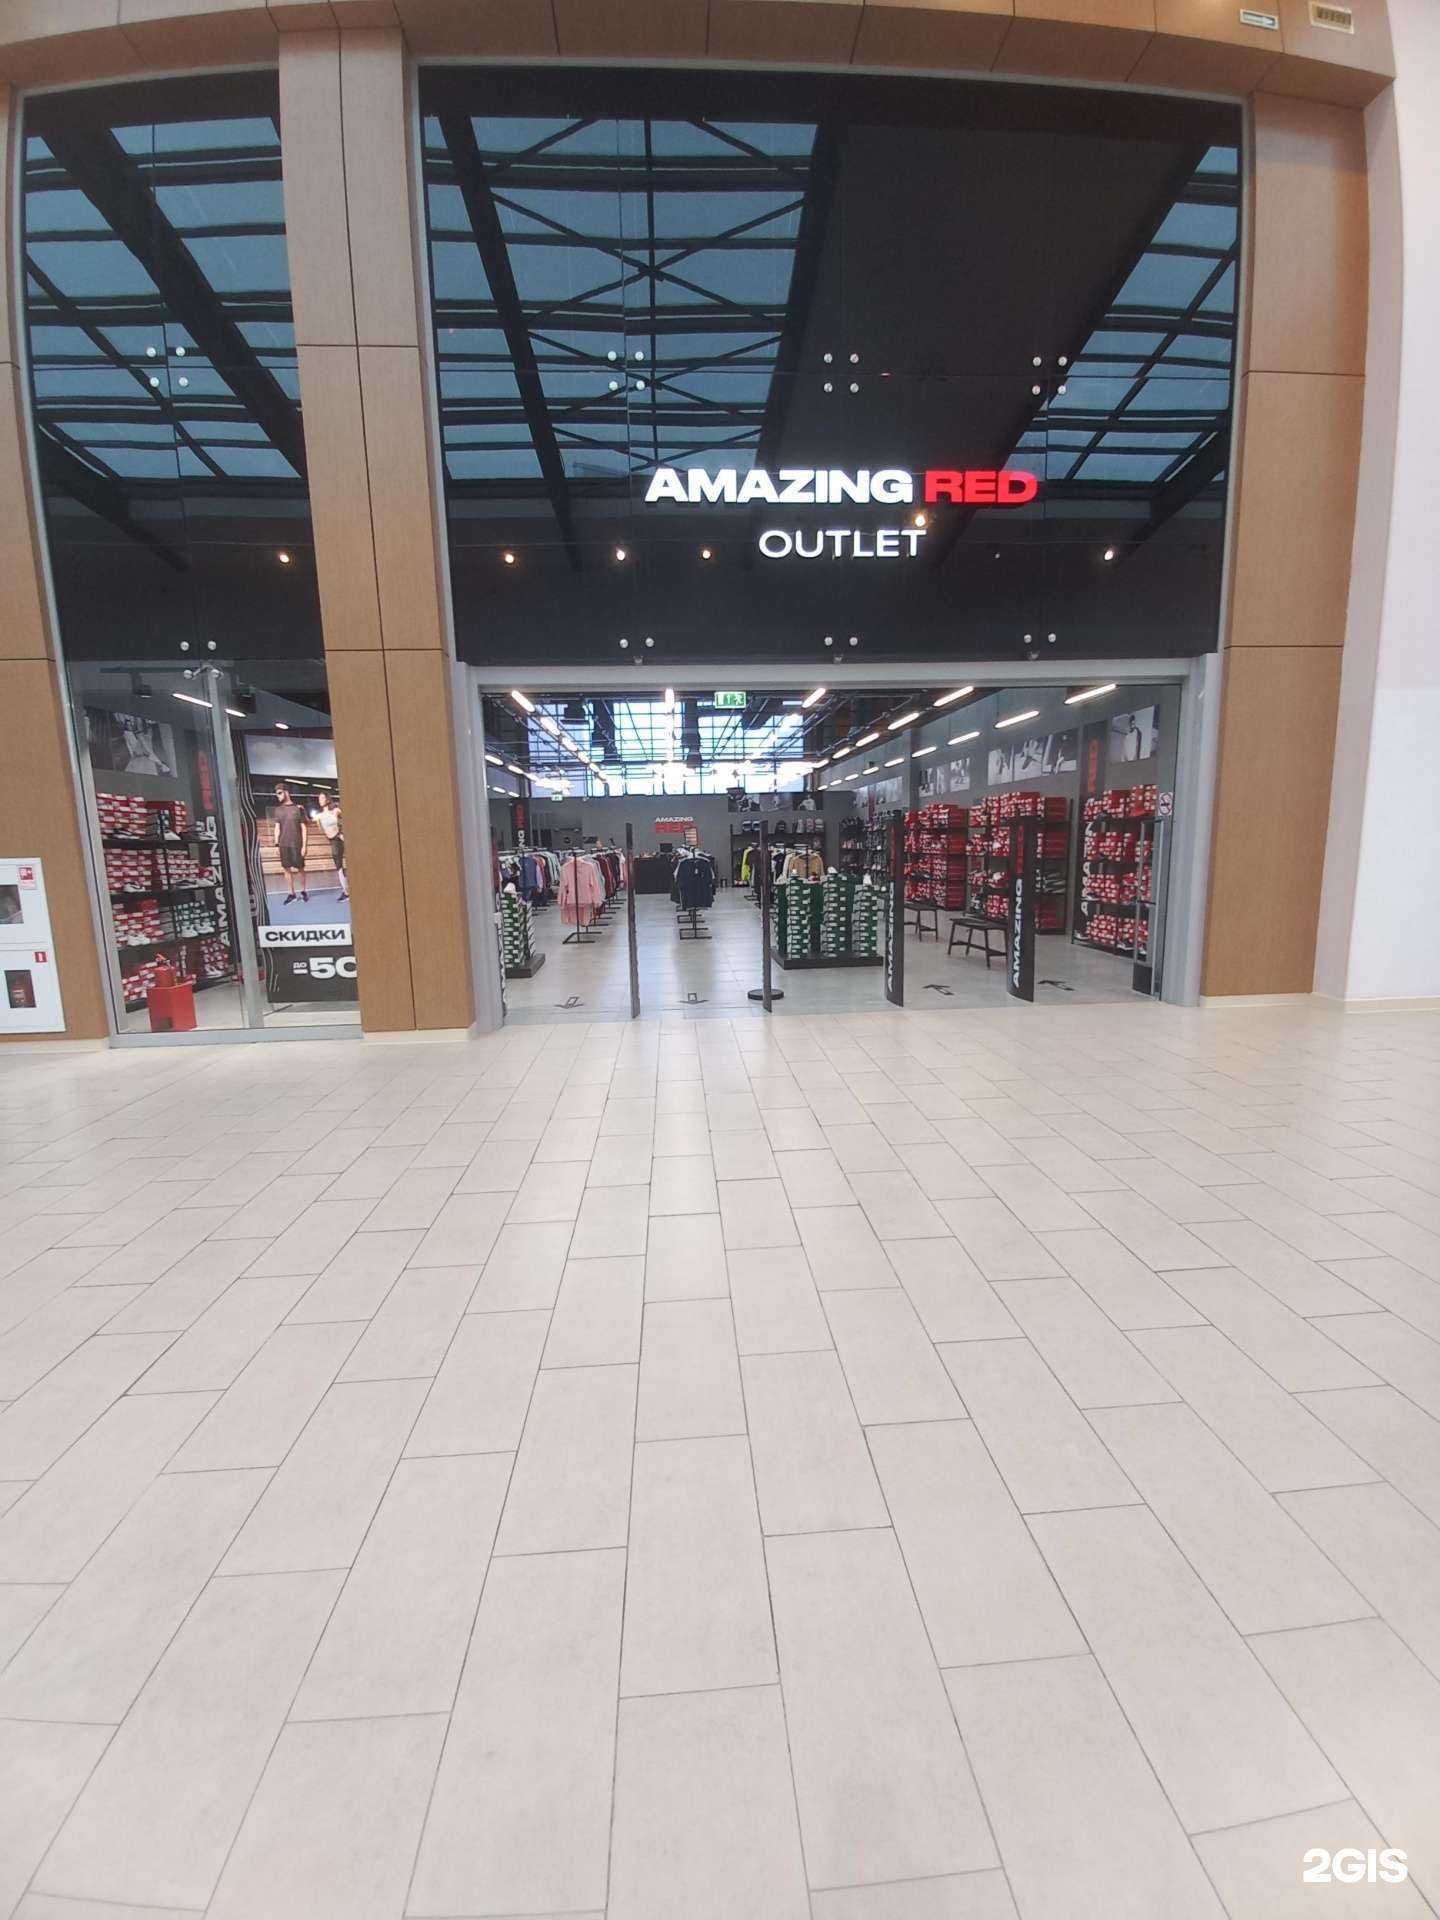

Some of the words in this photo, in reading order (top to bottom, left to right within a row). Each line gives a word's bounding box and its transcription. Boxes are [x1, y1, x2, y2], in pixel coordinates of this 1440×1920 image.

[644, 468, 914, 504] AMAZING
[924, 470, 1039, 504] RED
[758, 529, 927, 559] OUTLET
[265, 929, 346, 943] СКИДКИ
[887, 881, 895, 992] AMAZING
[1012, 878, 1024, 989] AMAZING
